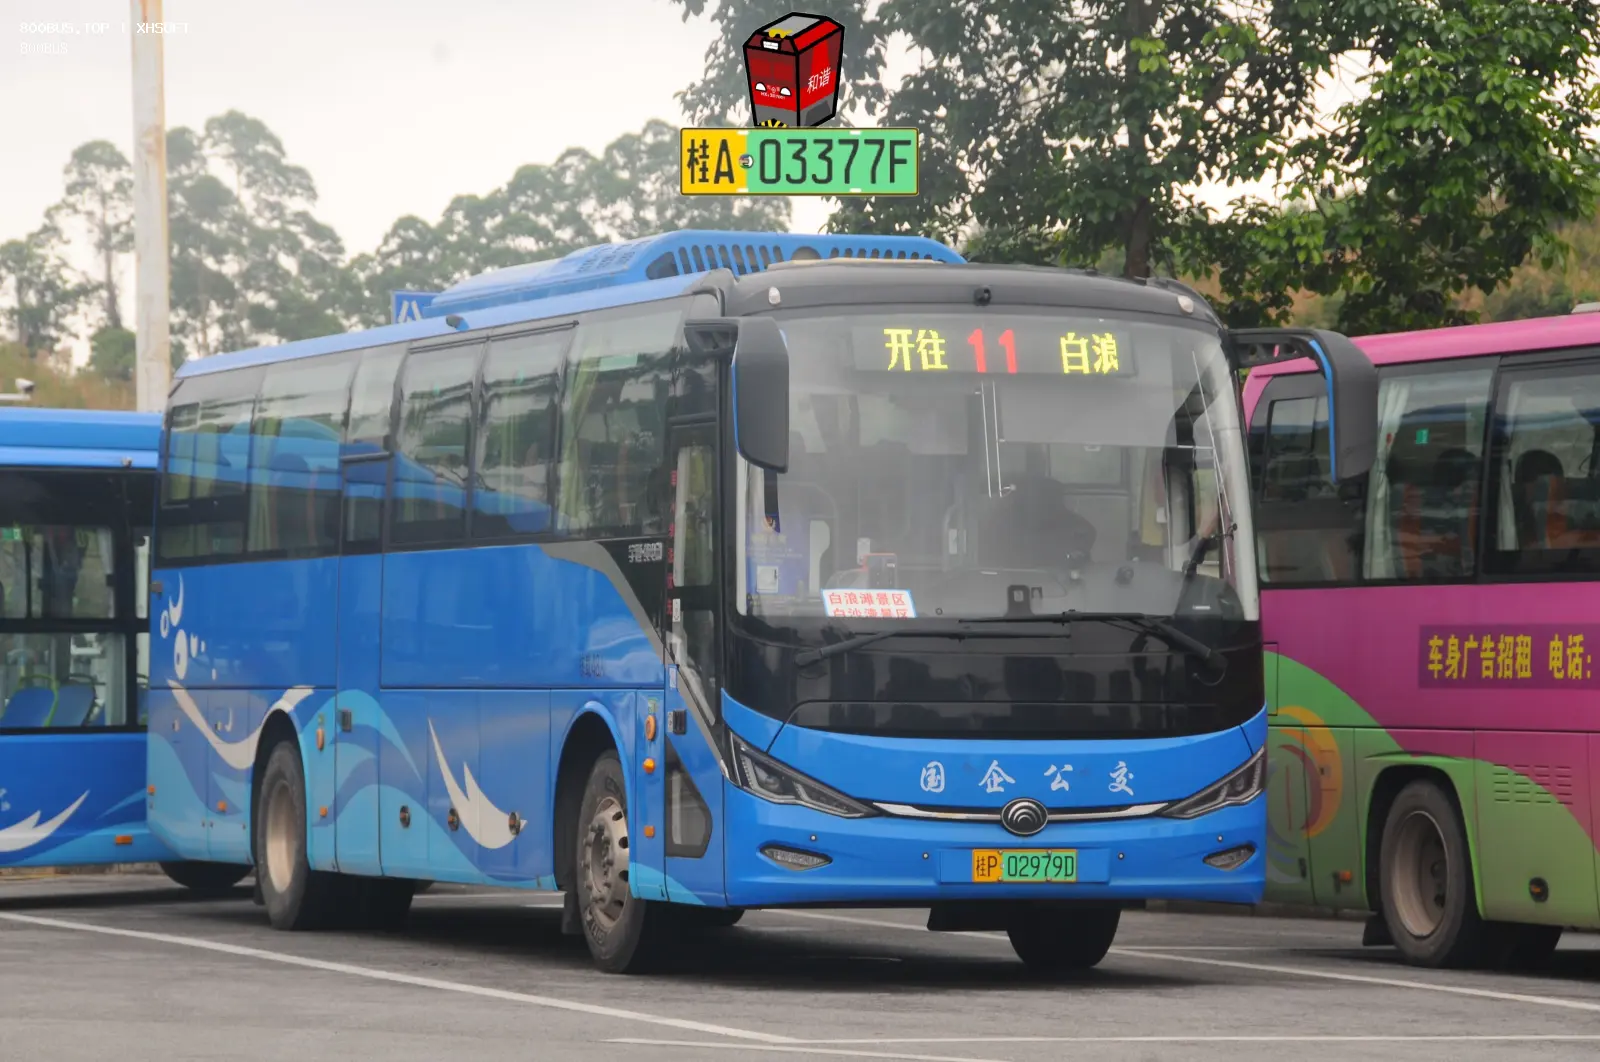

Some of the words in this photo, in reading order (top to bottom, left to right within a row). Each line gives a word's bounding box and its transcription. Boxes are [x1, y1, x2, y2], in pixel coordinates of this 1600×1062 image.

[883, 328, 949, 372] 开往
[967, 328, 1018, 375] 11
[1060, 332, 1119, 375] 白浪
[830, 592, 906, 606] 白浪滩景区
[1427, 634, 1532, 679] 车身广告招租
[920, 759, 1134, 796] 国企公交
